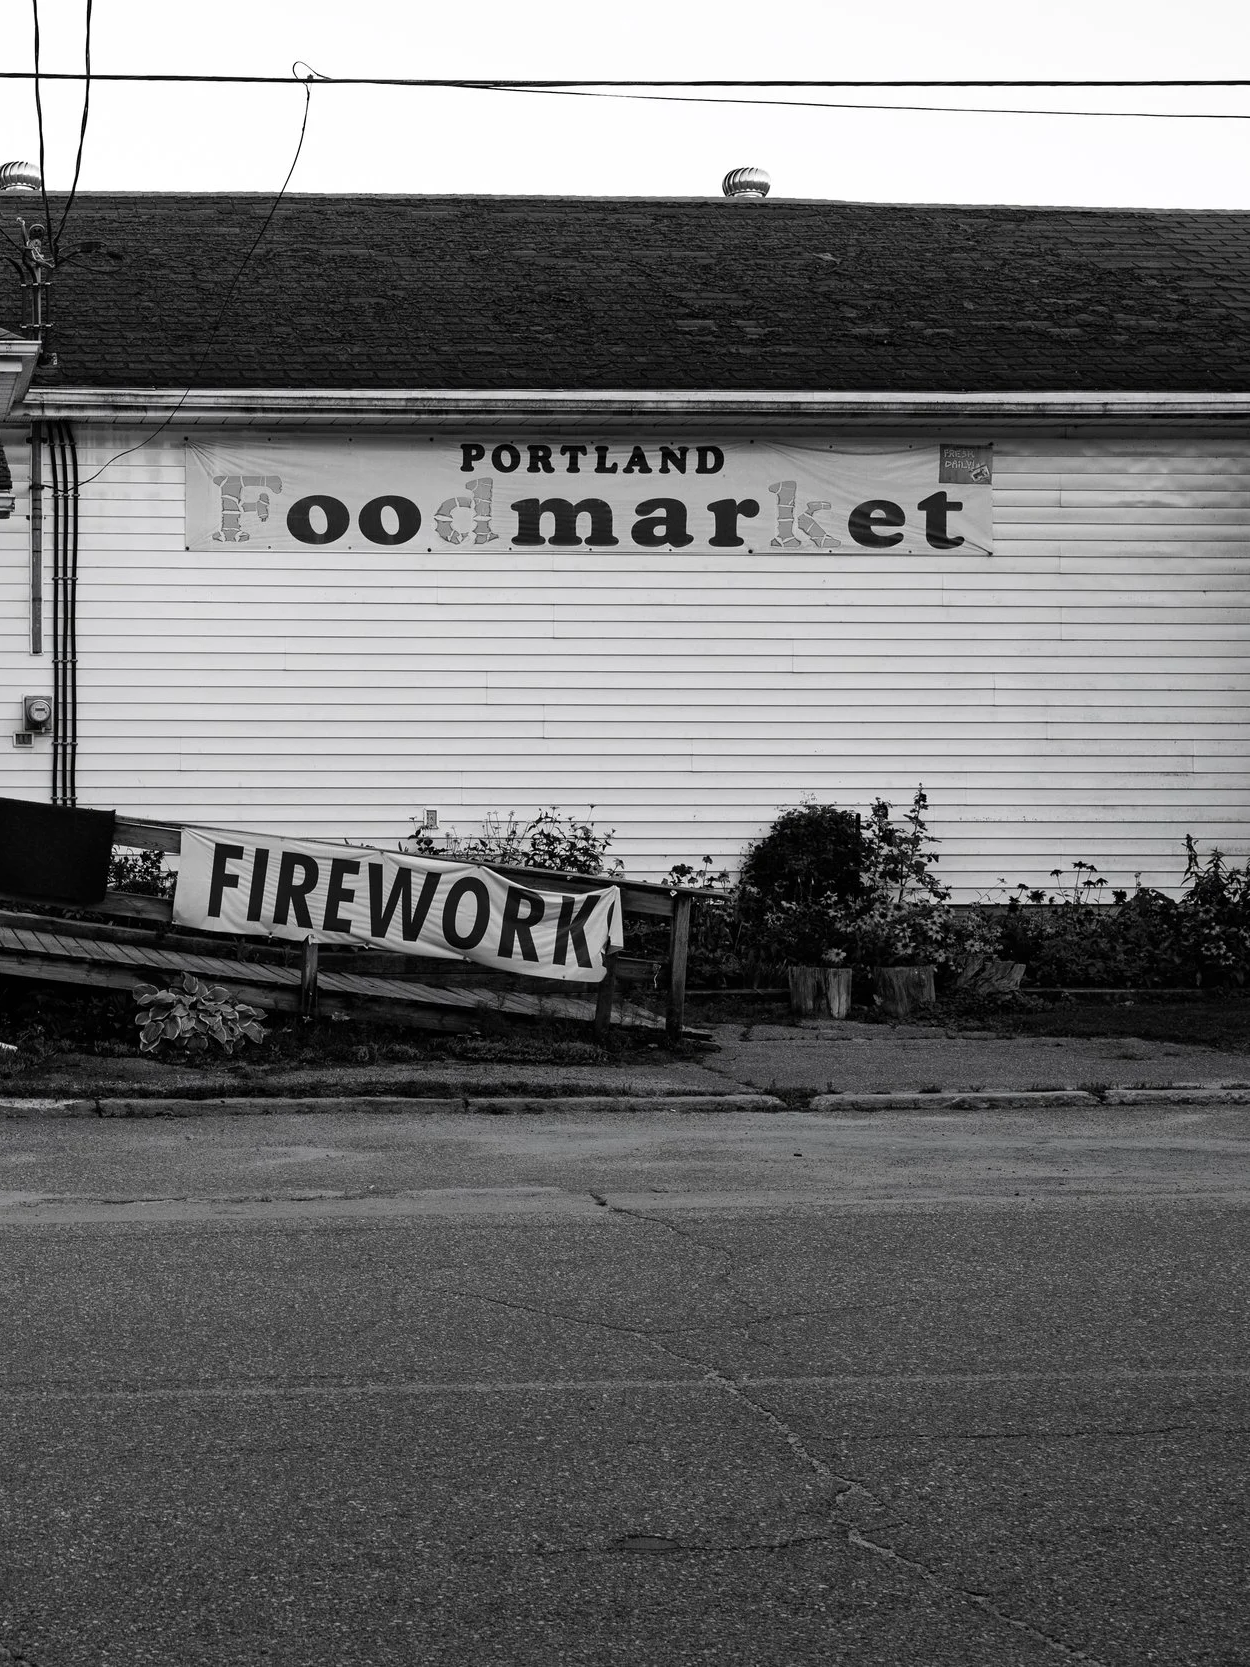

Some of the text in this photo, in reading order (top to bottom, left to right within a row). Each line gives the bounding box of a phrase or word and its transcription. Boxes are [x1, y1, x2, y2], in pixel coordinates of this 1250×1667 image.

[460, 443, 726, 475] PORTLAND
[944, 449, 975, 458] FRESH
[212, 474, 967, 550] Foodmarket
